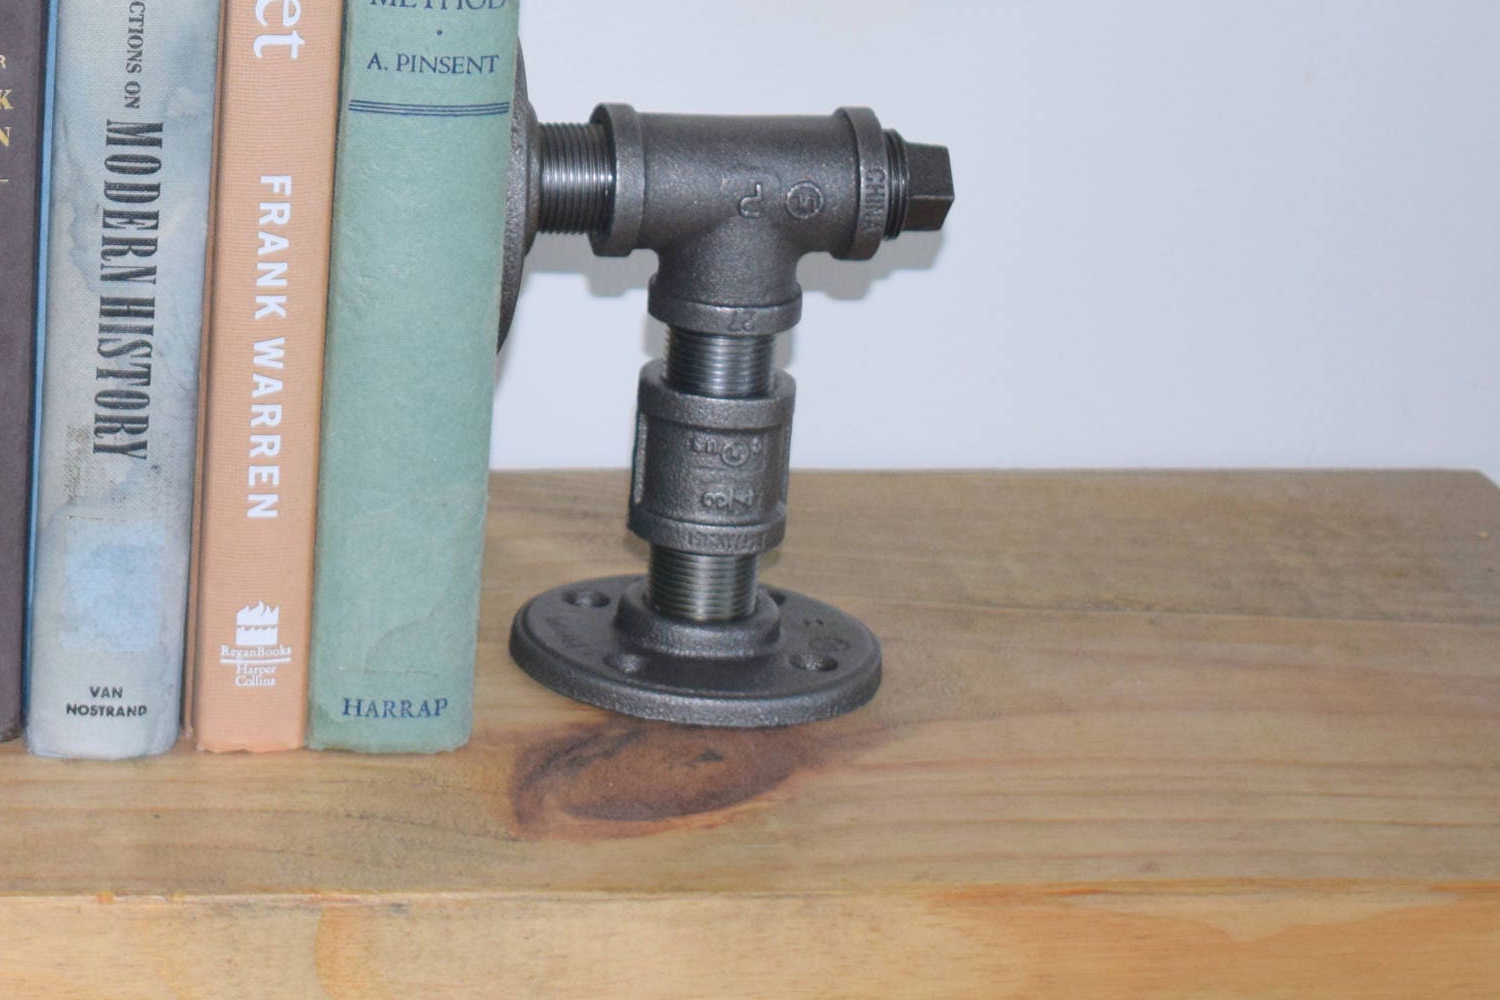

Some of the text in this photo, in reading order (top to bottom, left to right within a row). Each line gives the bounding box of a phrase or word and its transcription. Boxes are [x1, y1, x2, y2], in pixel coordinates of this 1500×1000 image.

[366, 52, 500, 75] A. PINSENT
[124, 81, 141, 110] ON
[92, 118, 164, 461] MODERN HISTORY
[246, 175, 292, 520] FRANK WARREN
[219, 643, 292, 659] ReganBooks
[235, 663, 277, 677] Harper
[235, 674, 276, 688] Collins
[89, 686, 123, 699] VAN
[66, 703, 148, 718] NOSTRAND
[342, 697, 449, 719] HARRAP
